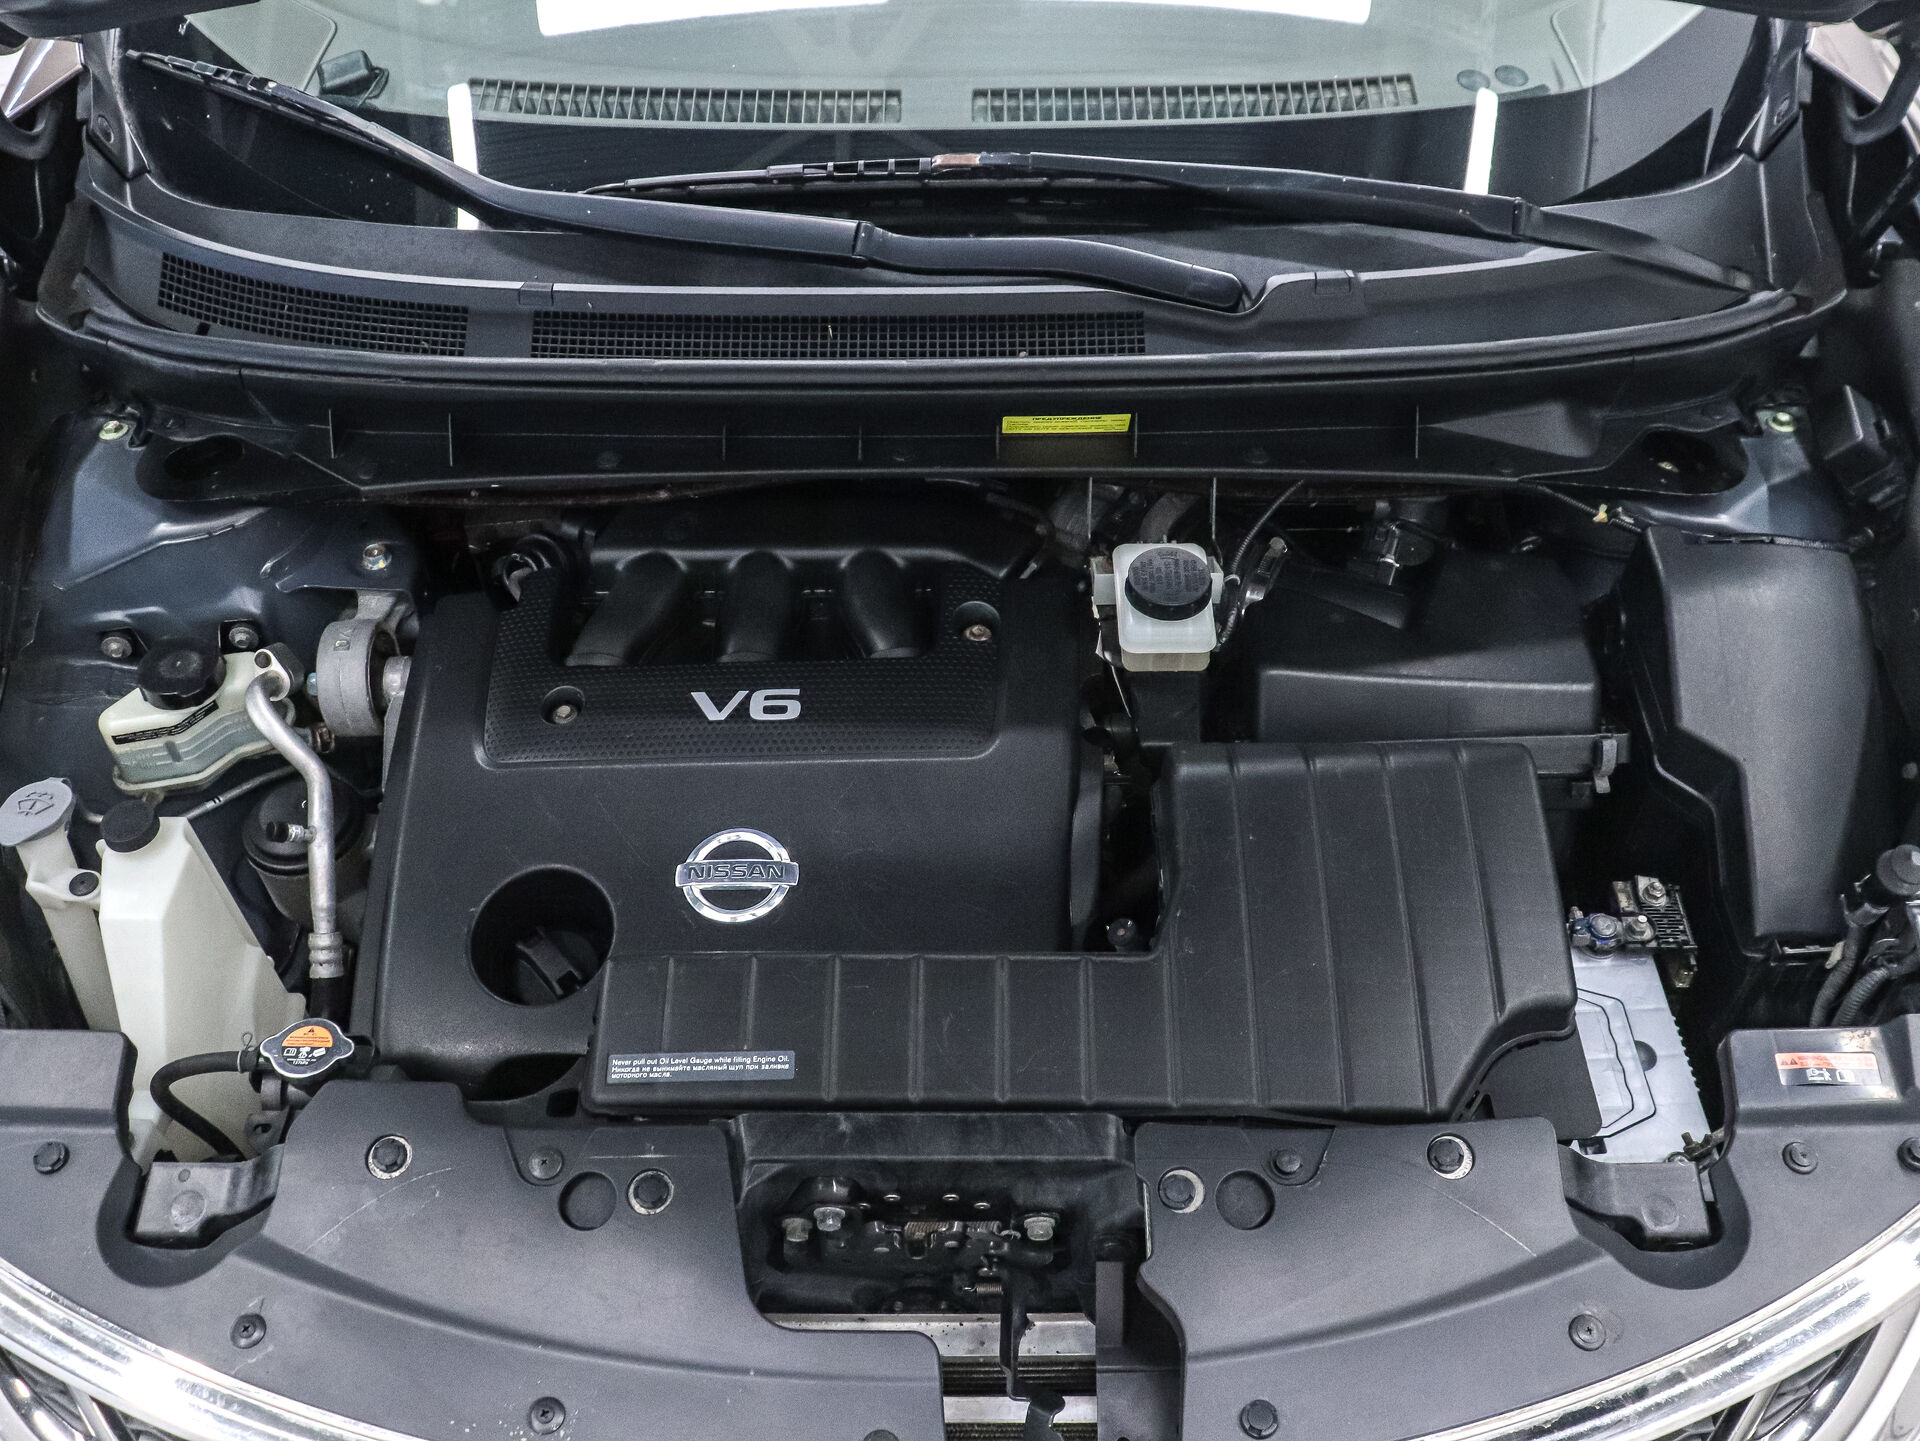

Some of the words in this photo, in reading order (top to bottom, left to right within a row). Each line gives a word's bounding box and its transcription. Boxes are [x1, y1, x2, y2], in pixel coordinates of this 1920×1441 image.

[690, 688, 801, 721] V6
[687, 863, 785, 880] NISSAN
[633, 1058, 646, 1066] pull
[659, 1057, 669, 1065] Oil
[690, 1056, 713, 1065] Gauge
[733, 1055, 751, 1064] filling
[753, 1055, 776, 1064] Engine
